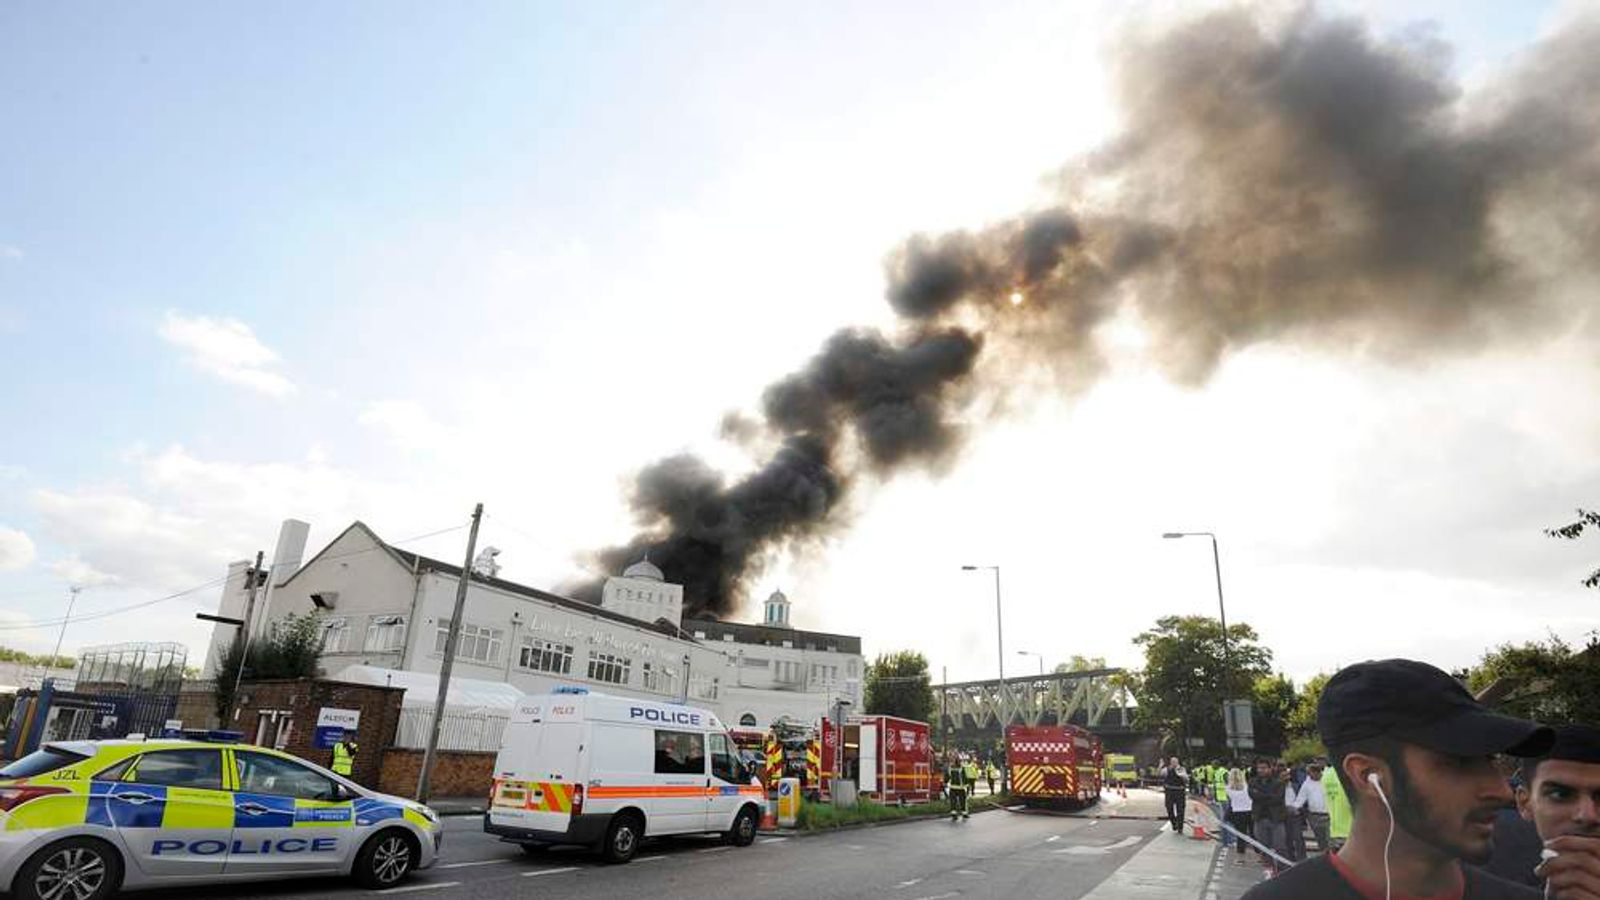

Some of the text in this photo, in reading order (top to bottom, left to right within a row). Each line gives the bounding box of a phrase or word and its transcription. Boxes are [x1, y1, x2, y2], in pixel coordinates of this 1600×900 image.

[630, 706, 700, 725] POLICE
[52, 769, 81, 780] JZL
[152, 837, 339, 856] POLICE
